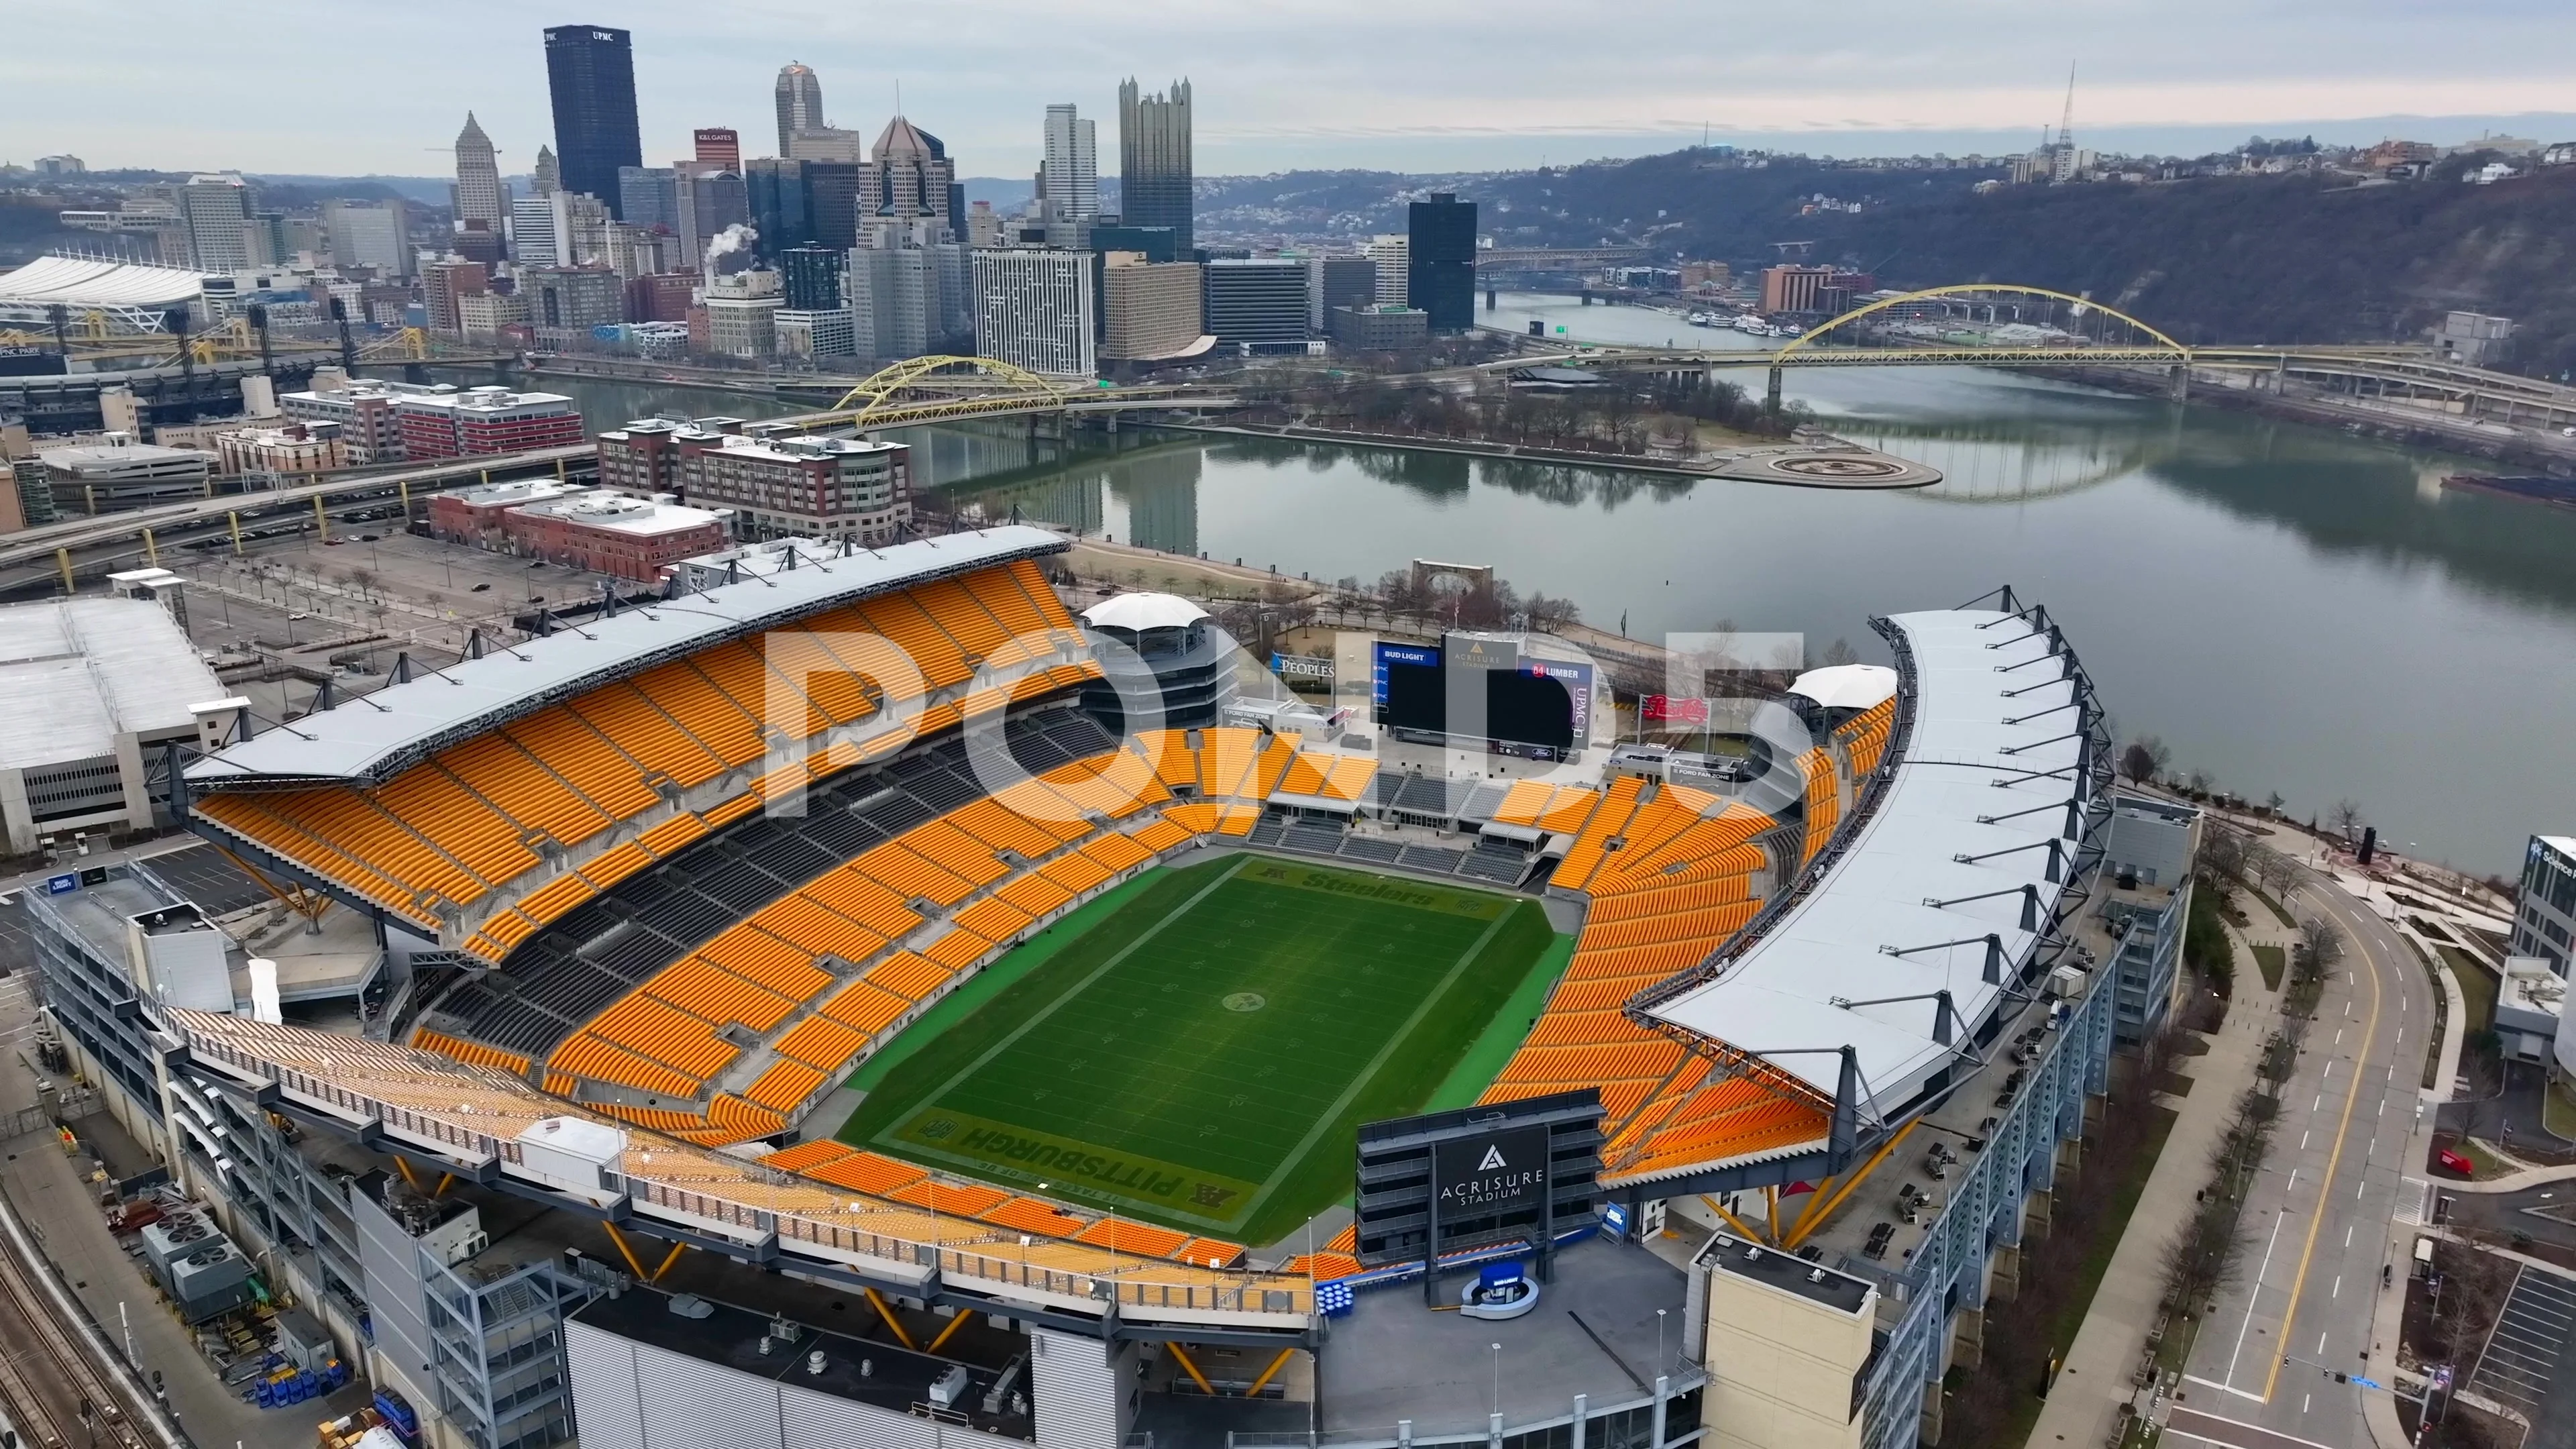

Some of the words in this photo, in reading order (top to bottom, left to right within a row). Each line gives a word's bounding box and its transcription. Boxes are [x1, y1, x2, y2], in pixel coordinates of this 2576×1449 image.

[592, 31, 613, 41] UPMC
[0, 348, 17, 356] PNC
[19, 347, 40, 355] PARK
[1385, 651, 1401, 659] BUD
[1401, 653, 1424, 661] LIGHT
[1454, 653, 1500, 663] ACRISURE
[1282, 659, 1335, 678] PEOPLES
[1546, 667, 1578, 679] LUMBER
[1575, 688, 1587, 724] UPMC
[2542, 851, 2573, 877] Science
[1301, 873, 1435, 906] Steelers
[958, 1127, 1187, 1198] PITTSBURGH
[977, 1162, 998, 1173] US
[1000, 1168, 1018, 1178] OF
[1054, 1179, 1099, 1199] TAKES
[1440, 1169, 1543, 1199] ACRISURE
[1460, 1187, 1521, 1206] STADIUM
